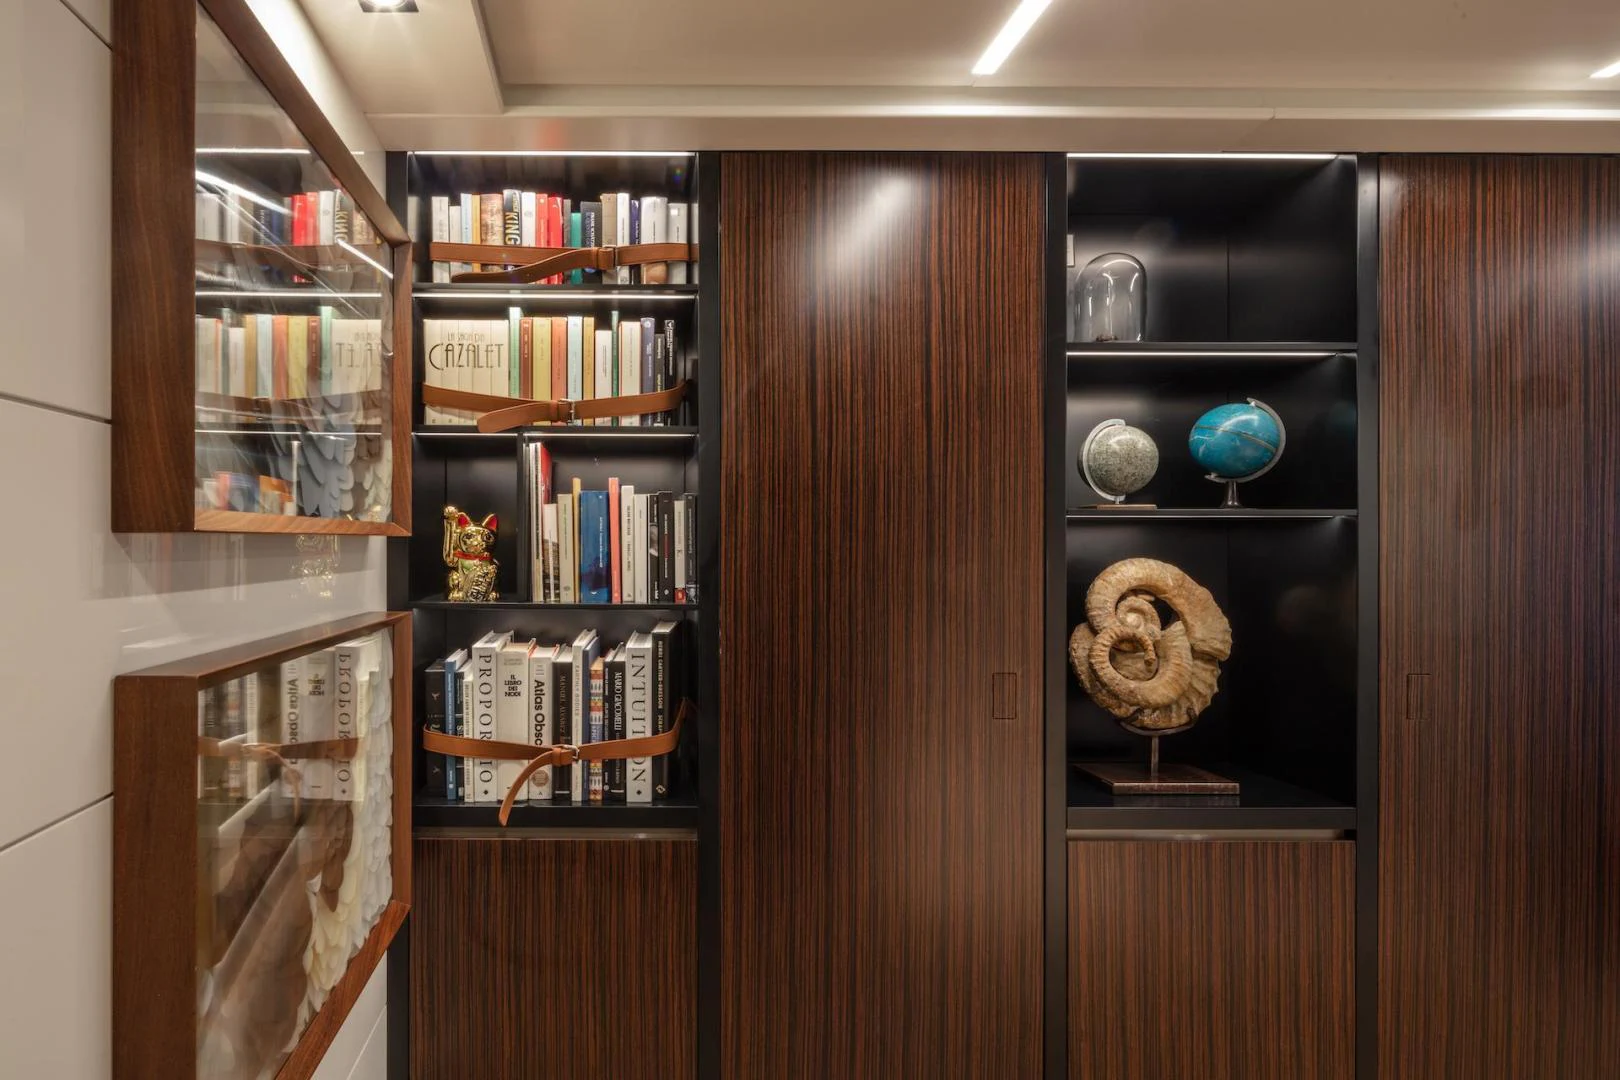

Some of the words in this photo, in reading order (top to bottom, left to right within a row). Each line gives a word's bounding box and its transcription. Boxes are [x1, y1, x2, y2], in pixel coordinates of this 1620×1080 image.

[505, 212, 520, 245] KING
[428, 343, 504, 371] CAZALET
[534, 679, 546, 710] Atlas
[613, 672, 622, 693] MARIO
[479, 654, 493, 783] PROPORIO
[613, 694, 622, 731] GIACOMELLI
[631, 654, 646, 783] INTUITON
[534, 713, 546, 746] Obsc
